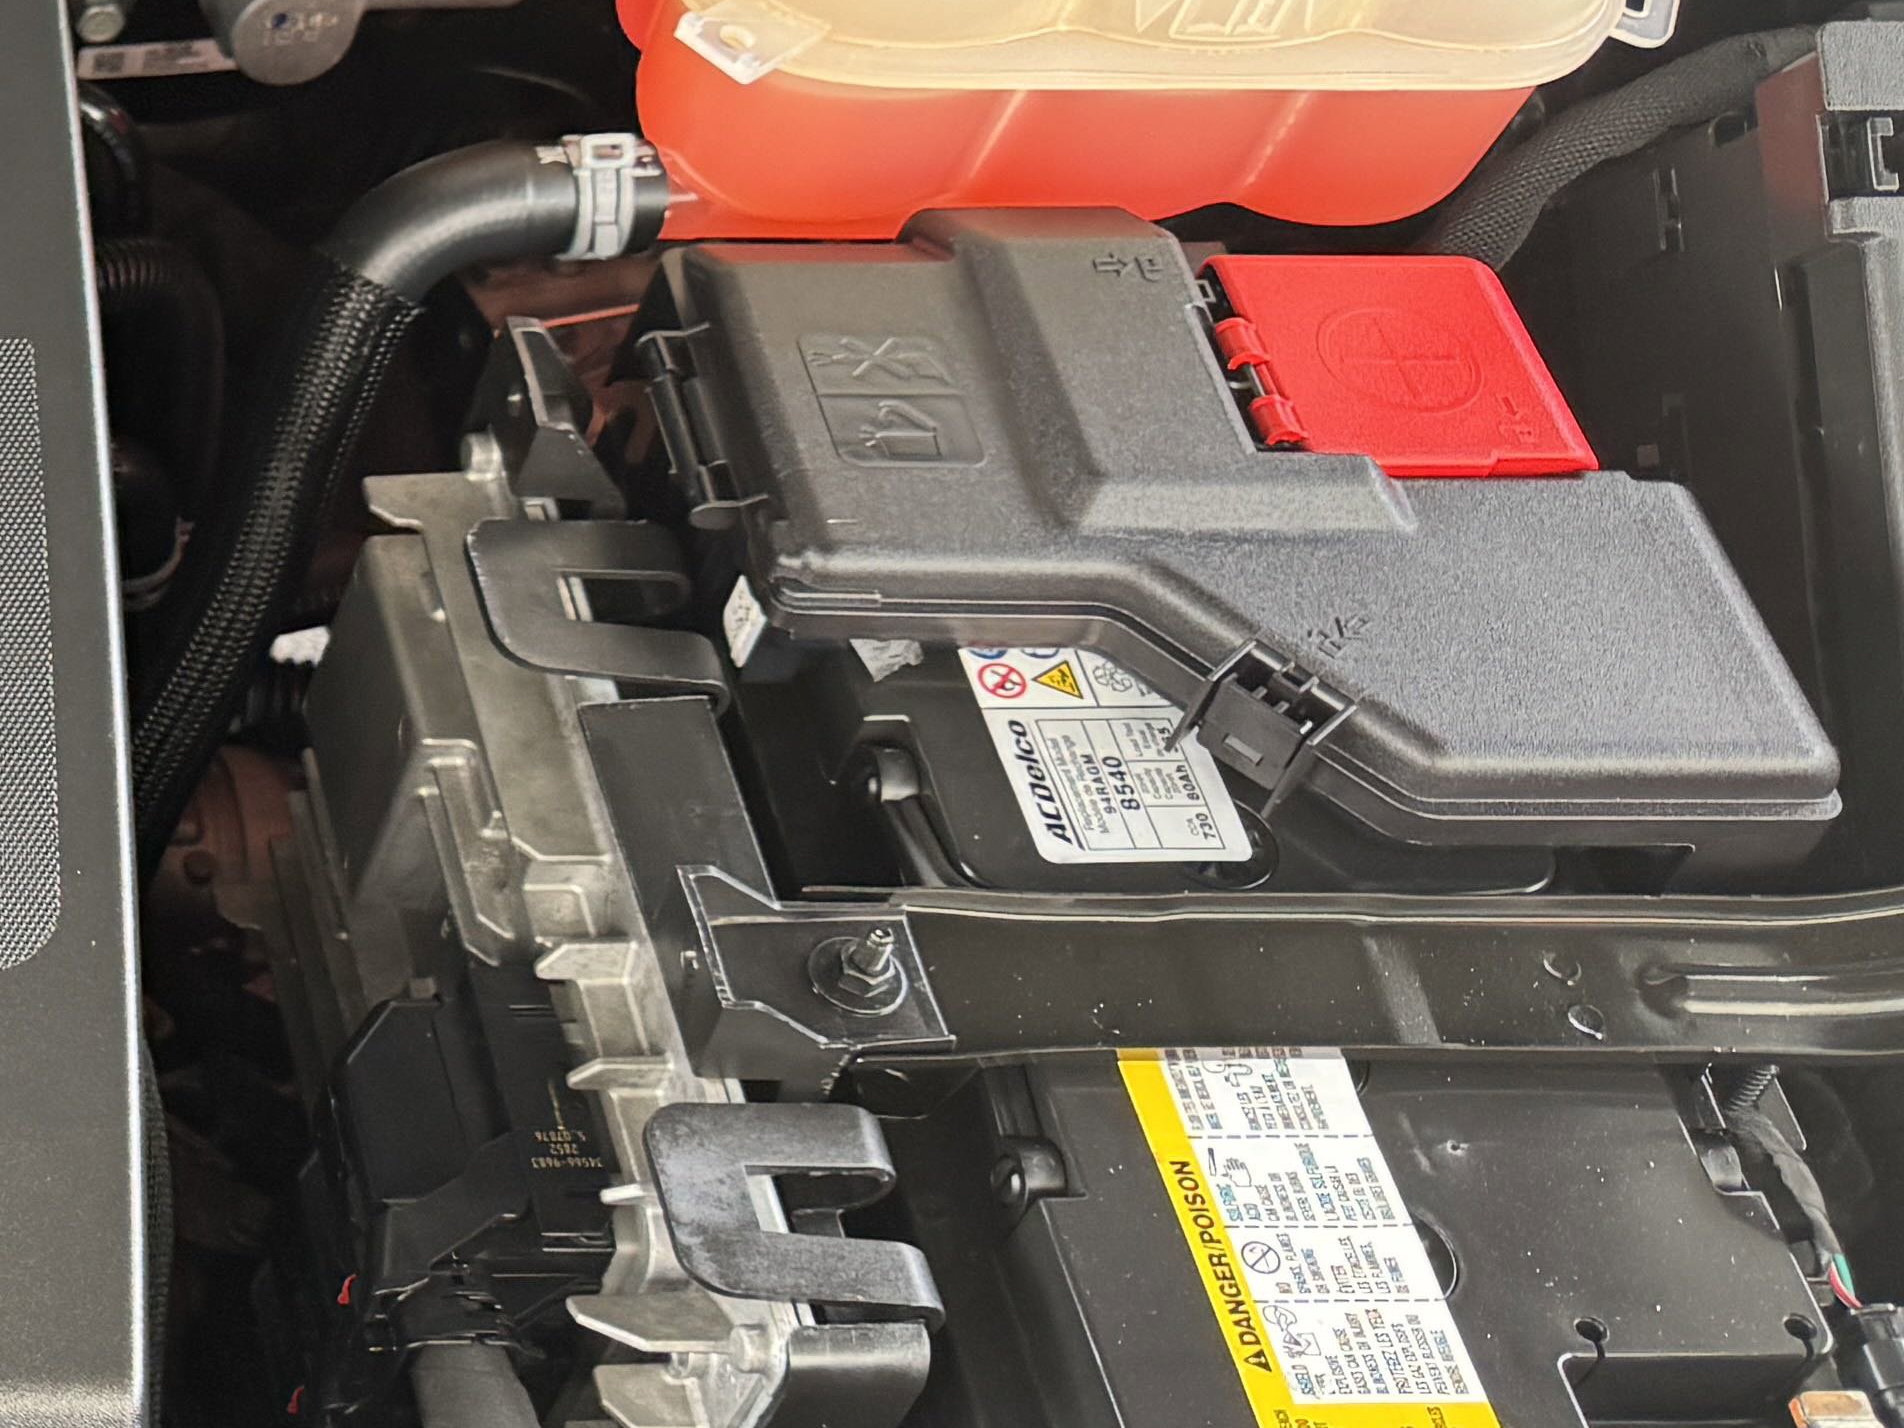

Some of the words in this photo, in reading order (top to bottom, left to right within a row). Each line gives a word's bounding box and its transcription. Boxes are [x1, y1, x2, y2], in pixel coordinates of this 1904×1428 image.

[1102, 756, 1140, 810] 8540
[1176, 765, 1200, 800] 80Ah
[1196, 813, 1216, 839] 730
[1169, 1162, 1261, 1345] DANGER/POISON
